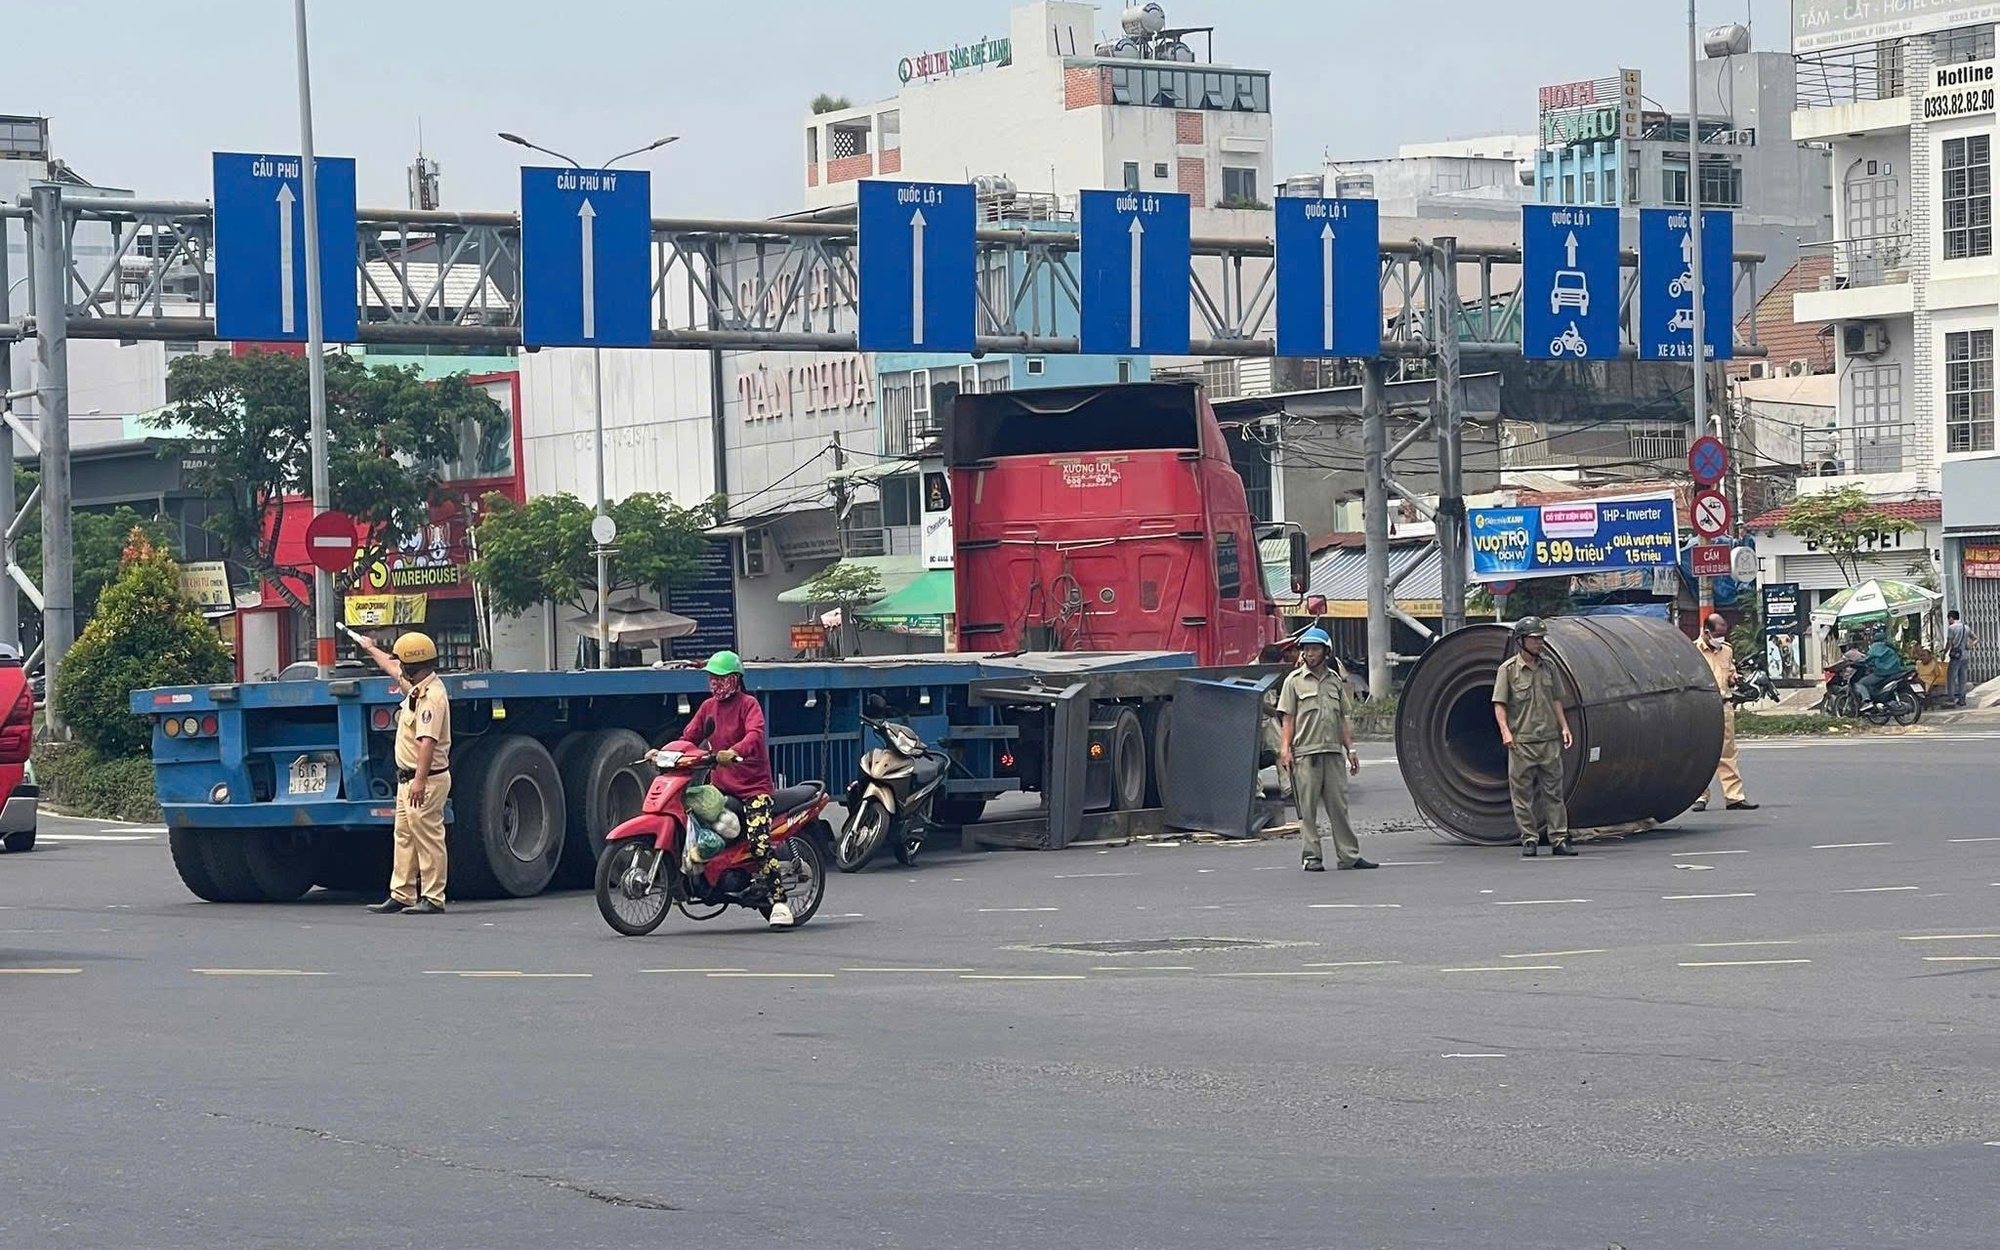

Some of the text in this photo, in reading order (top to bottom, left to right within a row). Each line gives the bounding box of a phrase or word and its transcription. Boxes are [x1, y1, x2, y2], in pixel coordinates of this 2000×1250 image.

[917, 50, 934, 78] SIÊU
[934, 52, 949, 76] THỊ
[1937, 66, 1993, 86] Hotline
[1540, 81, 1597, 110] HOTEL
[1924, 89, 1994, 118] 0333.82.82.90
[252, 155, 273, 177] CẦU
[277, 159, 299, 178] PHÚ
[557, 168, 617, 192] CẦU PHÚ MỸ
[897, 183, 942, 206] QUỐC LỘ 1
[1116, 192, 1160, 215] QUỐC LỘ 1
[1305, 199, 1347, 221] QUỐC LỘ 1
[1551, 206, 1591, 228] QUỐC LỘ 1
[1667, 211, 1705, 231] QUỐC 1
[1658, 343, 1669, 357] XE
[1669, 344, 1676, 357] 2
[1677, 340, 1687, 357] VÀ
[1687, 344, 1693, 357] 3
[1602, 508, 1620, 522] 1HP
[1626, 507, 1662, 521] Inverter
[1613, 532, 1632, 548] QUÀ
[1655, 532, 1672, 548] trội
[1499, 550, 1525, 563] DỊCH VỤ
[1536, 540, 1613, 566] 5,99 triệu +
[1625, 549, 1661, 564] 1,5 triệu
[1703, 549, 1720, 562] CẤM
[391, 567, 458, 588] WAREHOUSE
